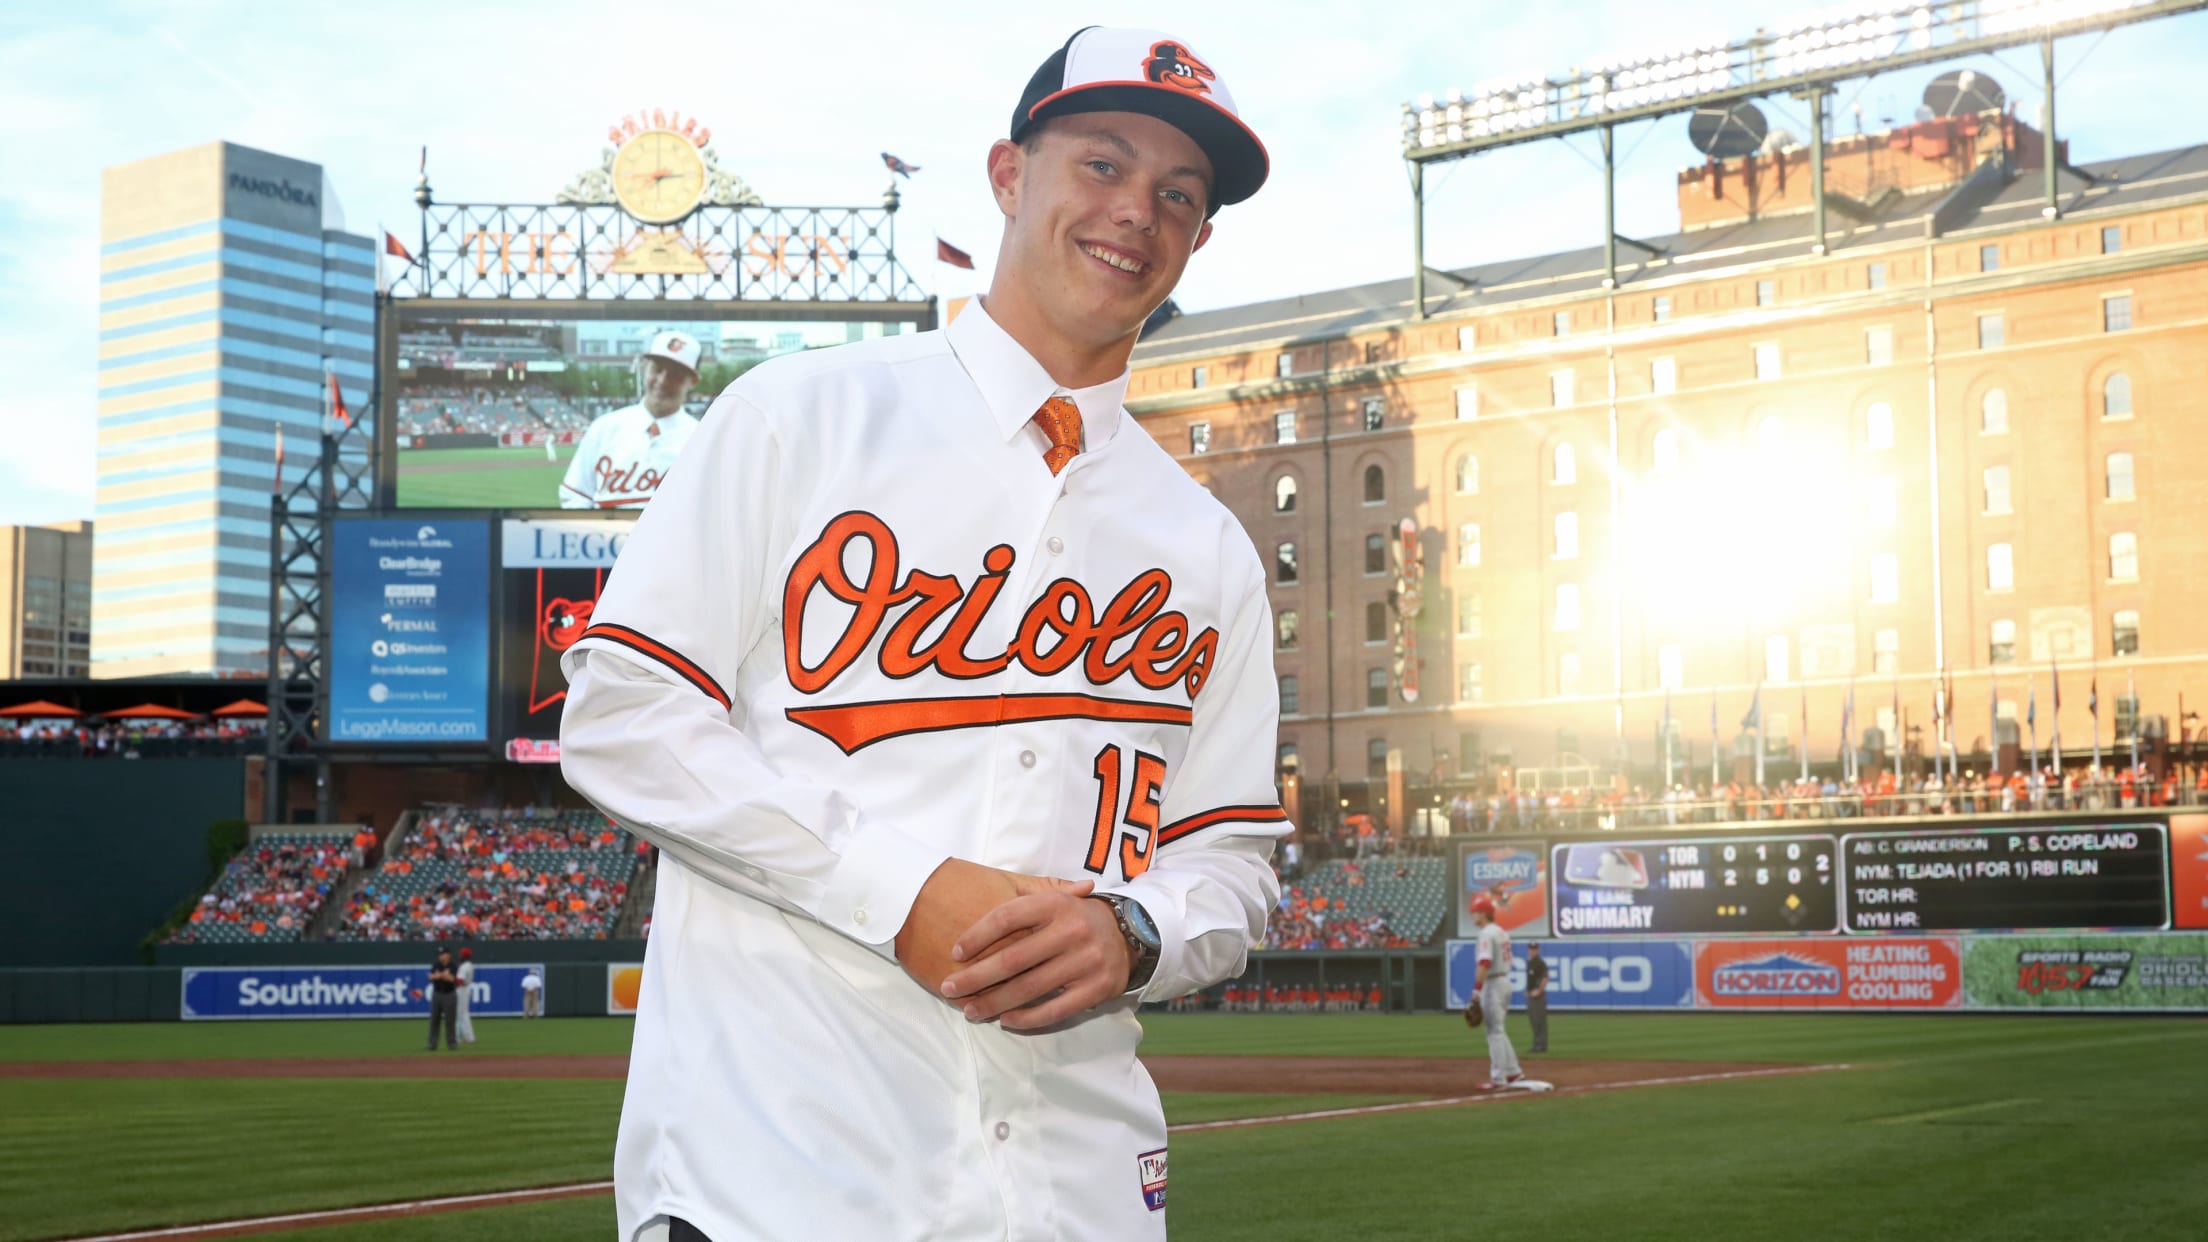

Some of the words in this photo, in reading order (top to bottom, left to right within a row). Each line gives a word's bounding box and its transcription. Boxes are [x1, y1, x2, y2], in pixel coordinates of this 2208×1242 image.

[464, 232, 575, 275] THE
[744, 232, 851, 277] SUN
[782, 510, 1219, 701] Orioles
[340, 720, 477, 739] LeggMason.com
[1085, 743, 1167, 882] 15
[2047, 832, 2138, 851] COPELAND
[1668, 847, 1699, 866] TOR
[1723, 846, 1737, 862] 0
[1757, 845, 1766, 861] 1
[1787, 843, 1800, 861] 0
[1816, 854, 1829, 871] 2
[1473, 863, 1531, 878] ESSKAY
[1668, 870, 1705, 890] NYM
[1724, 869, 1737, 886] 2
[1756, 868, 1769, 885] 5
[1788, 868, 1801, 884] 0
[1855, 864, 1893, 881] NYM:
[1896, 862, 1956, 880] TEJADA
[1975, 861, 2010, 878] FOR
[2031, 860, 2058, 877] RBI
[2062, 859, 2099, 876] RUN
[1856, 888, 1889, 904] TOR
[1560, 907, 1653, 930] SUMMARY
[1857, 912, 1890, 928] NYM
[1847, 945, 1930, 963] HEATING
[2020, 951, 2081, 963] SPORTS
[2083, 950, 2131, 963] RADIO
[1717, 972, 1836, 991] HORIZON
[1848, 963, 1946, 982] PLUMBING
[2090, 975, 2120, 986] FAN
[239, 976, 407, 1006] Southwest
[1848, 982, 1933, 1000] COOLING
